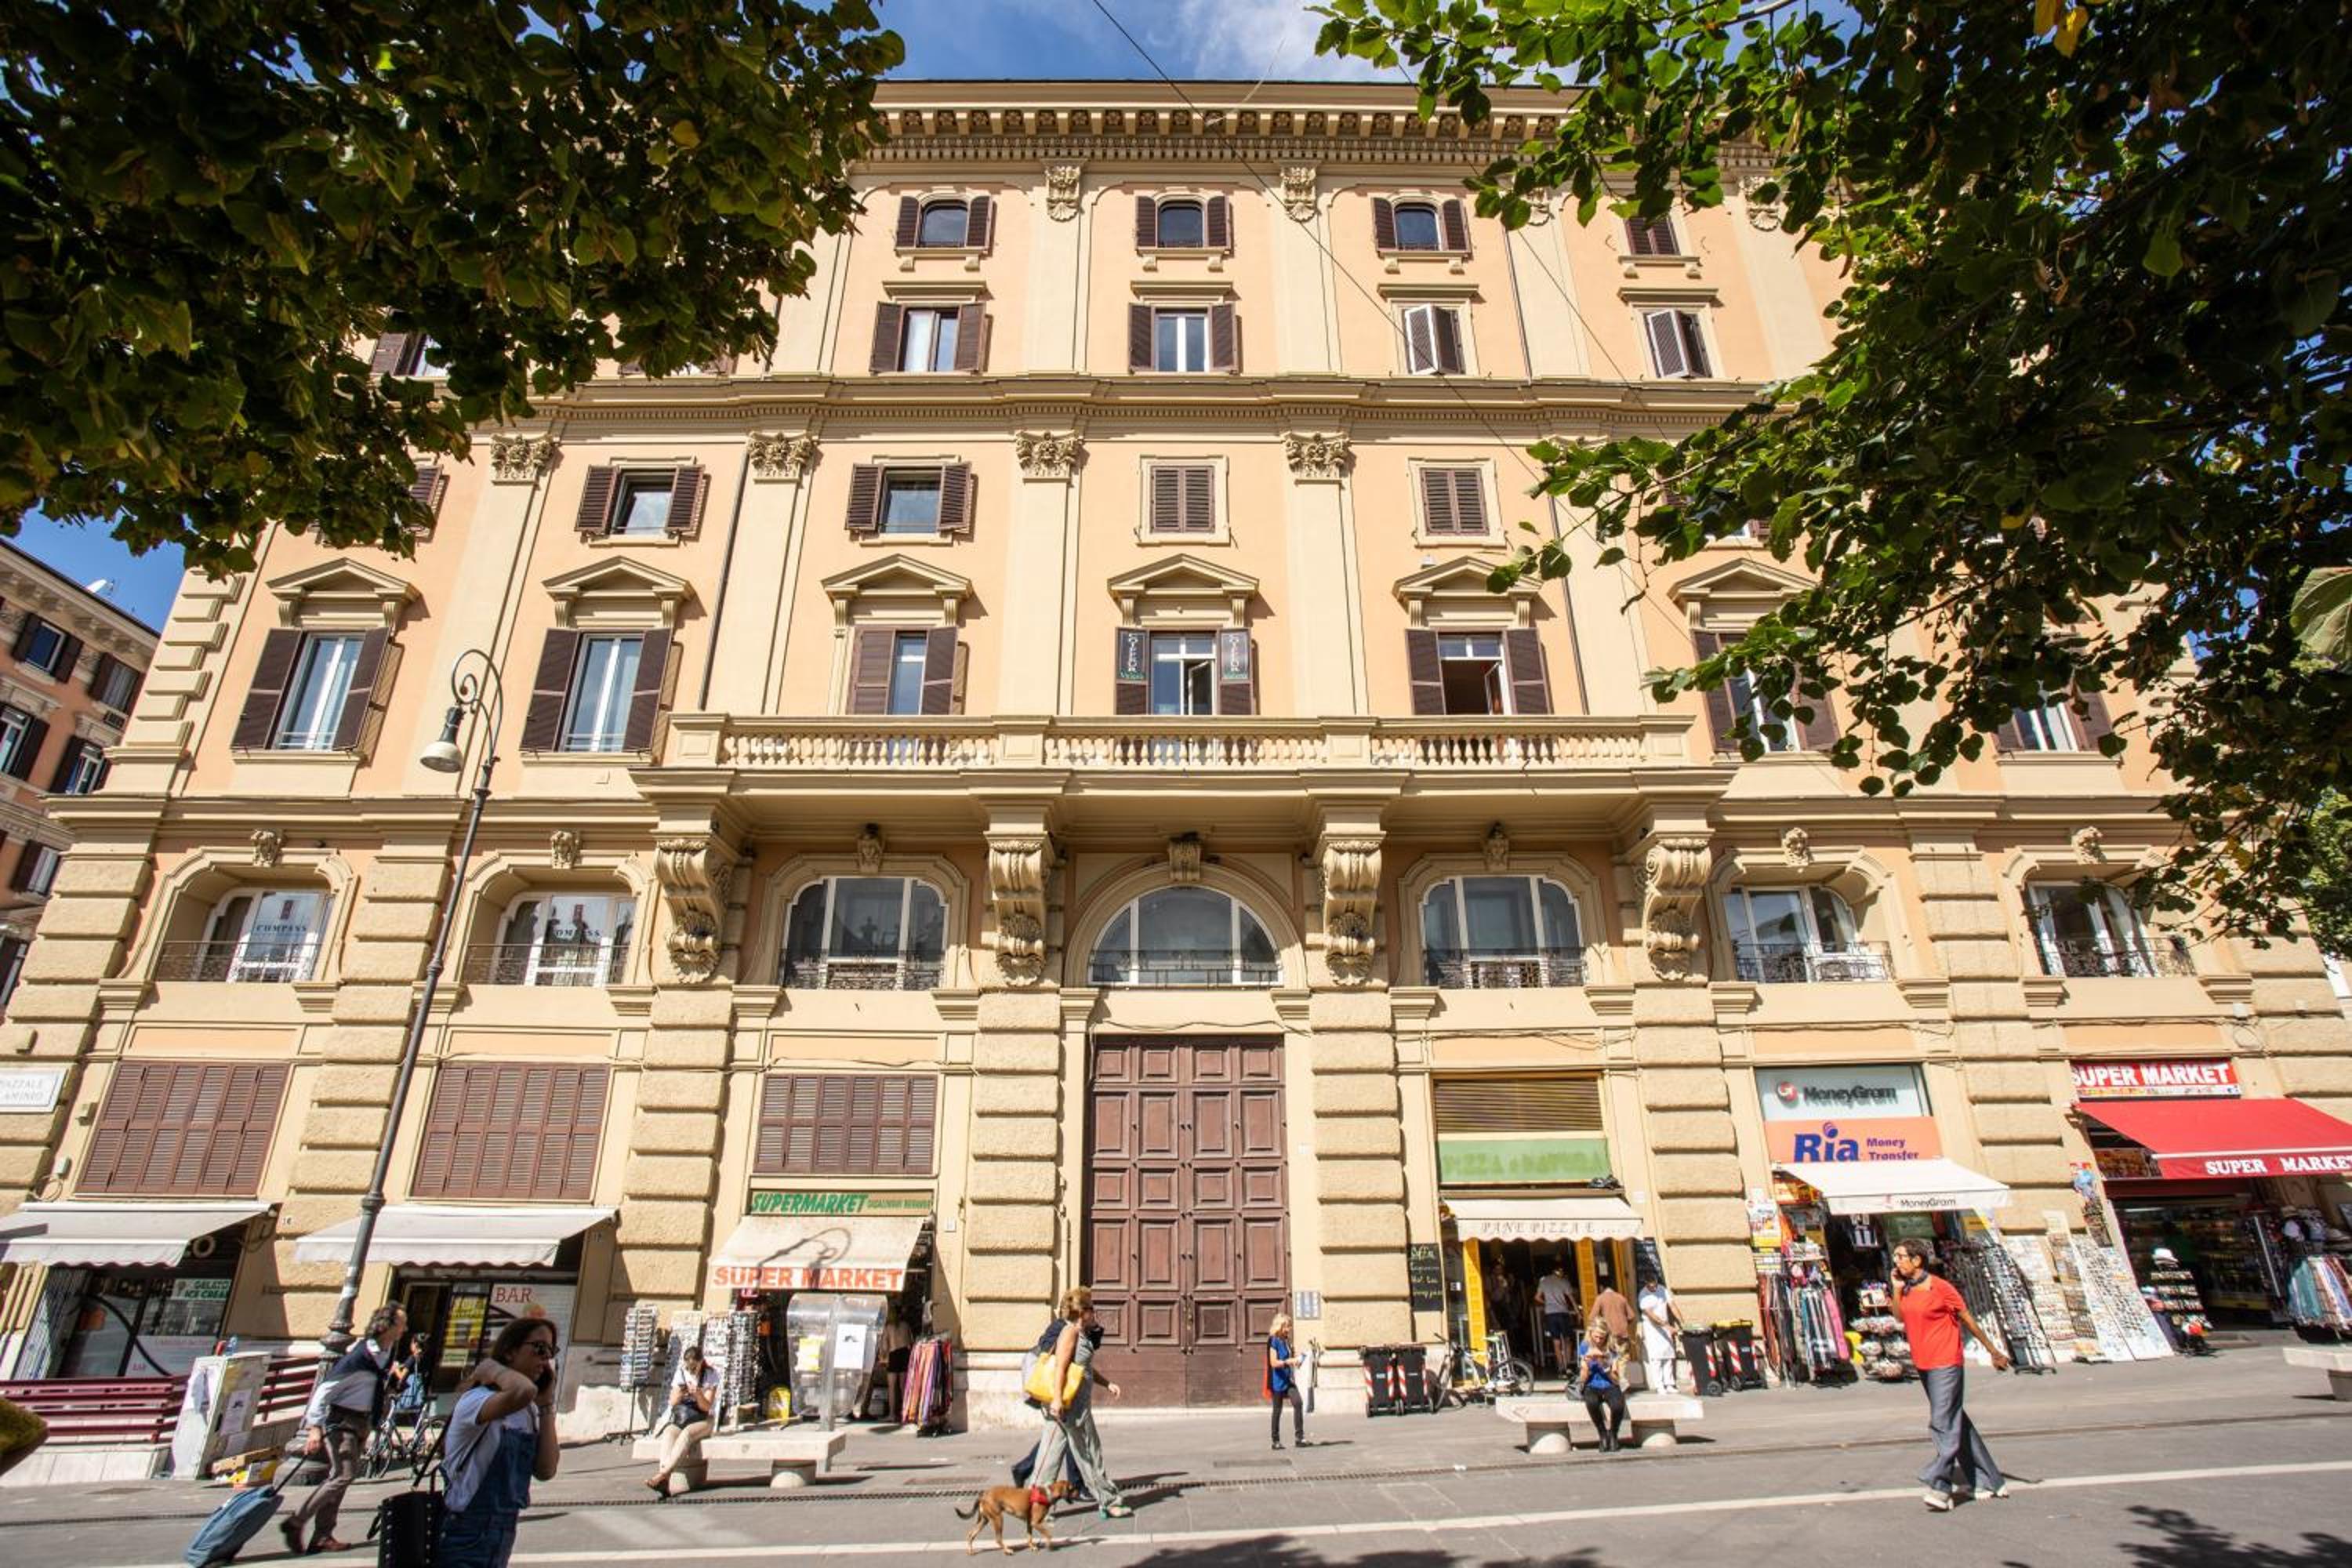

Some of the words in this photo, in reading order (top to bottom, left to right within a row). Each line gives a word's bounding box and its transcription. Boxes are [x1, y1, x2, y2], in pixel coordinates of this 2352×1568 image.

[2140, 1063, 2230, 1085] MARKET
[1804, 1085, 1896, 1103] MoneyGram
[1794, 1122, 1860, 1163] Ria
[1866, 1138, 1906, 1149] Money
[1868, 1150, 1919, 1161] Transfer
[2205, 1158, 2268, 1175] SUPER
[752, 1193, 869, 1214] SUPERMARKET
[1900, 1197, 1957, 1207] MoneyGram
[713, 1266, 793, 1287] SUPER
[801, 1267, 903, 1290] MARKET
[495, 1287, 532, 1303] BAR
